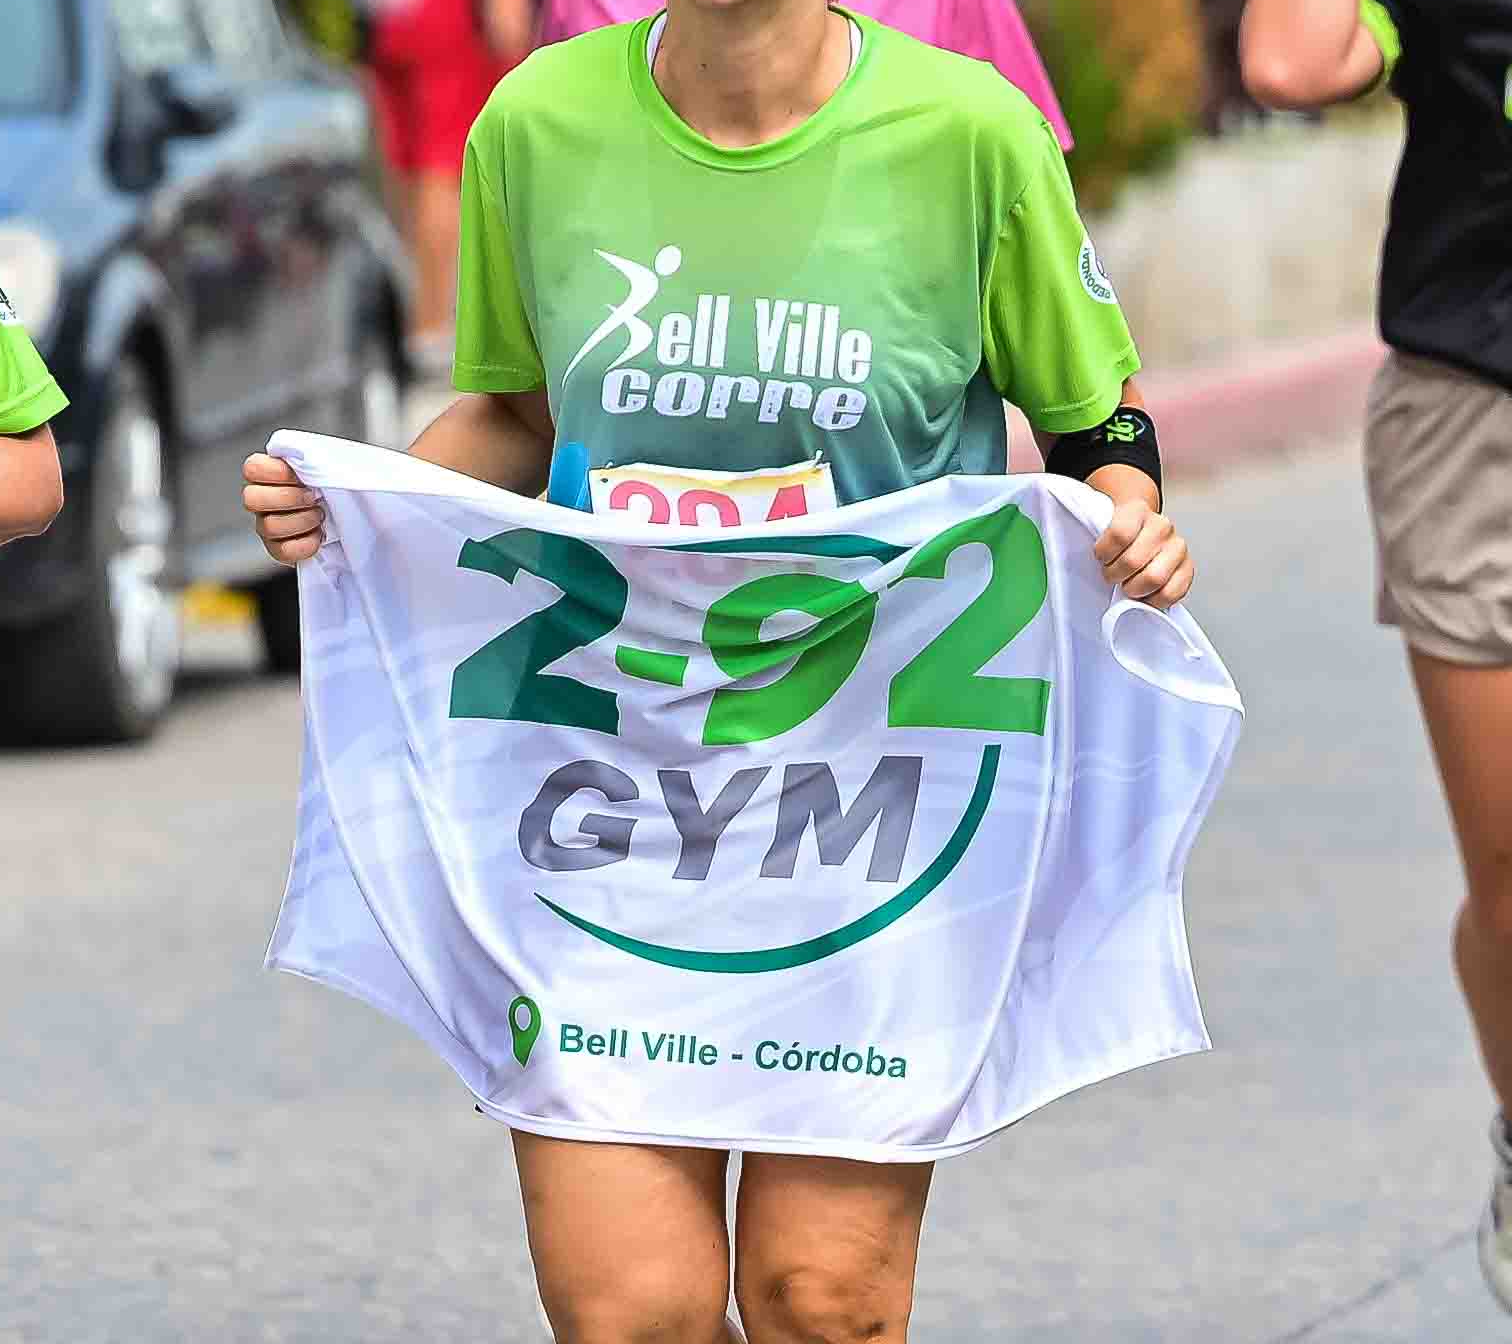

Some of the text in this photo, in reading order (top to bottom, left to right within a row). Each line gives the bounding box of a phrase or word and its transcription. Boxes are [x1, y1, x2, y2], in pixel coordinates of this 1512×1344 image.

[754, 297, 874, 384] Ville
[601, 368, 868, 432] corre
[448, 502, 1054, 746] 2-92
[515, 756, 924, 885] GYM
[559, 1023, 628, 1059] Bell
[642, 1031, 719, 1066] Ville
[755, 1040, 907, 1078] Córdoba
